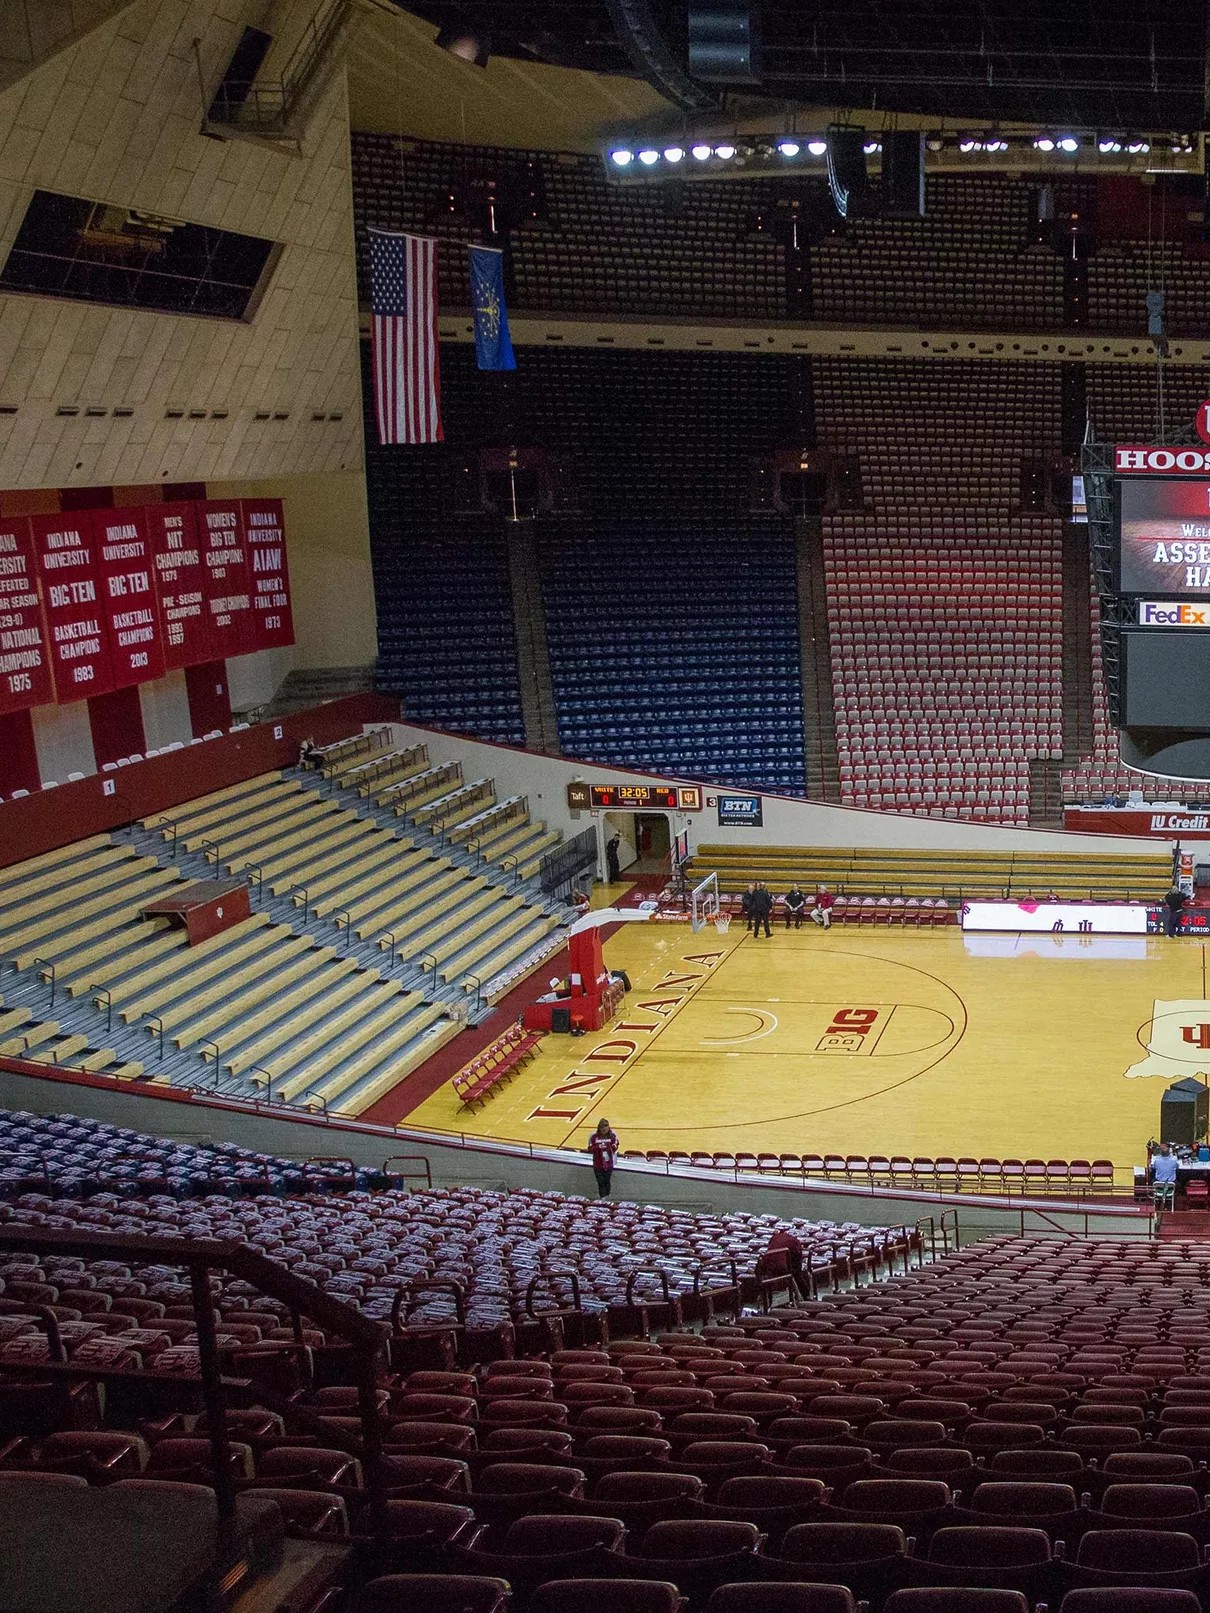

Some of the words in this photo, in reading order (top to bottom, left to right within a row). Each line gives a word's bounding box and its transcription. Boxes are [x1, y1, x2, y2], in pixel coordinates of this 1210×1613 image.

[47, 531, 81, 549] INDIANA
[106, 524, 138, 542] INDIANA
[167, 531, 183, 549] NIT
[210, 532, 222, 547] BIG
[43, 549, 90, 569] UNIVERSITY
[102, 542, 145, 561] UNIVERSITY
[155, 549, 199, 570] CHAMPIONS
[108, 575, 126, 597] BIG
[127, 571, 149, 594] TEN
[11, 594, 38, 610] SEASON
[50, 584, 70, 608] BIG
[71, 580, 96, 602] TEN
[113, 608, 153, 629] BASKETBALL
[1145, 604, 1206, 624] FedEx
[1, 627, 42, 650] NATIONAL
[54, 620, 101, 641] BASKETBALL
[118, 626, 153, 646] CHAMPIONS
[60, 639, 100, 660] CHAMPIONS
[130, 652, 148, 669] 2013
[8, 673, 32, 693] 1975
[73, 665, 94, 683] 1983
[571, 792, 585, 800] Taft
[603, 795, 609, 804] 0
[621, 787, 647, 797] 32:05
[709, 798, 716, 806] 3
[724, 801, 752, 811] BTN
[1151, 815, 1166, 828] IU
[1168, 815, 1208, 828] Credit
[524, 949, 727, 1124] INDIANA
